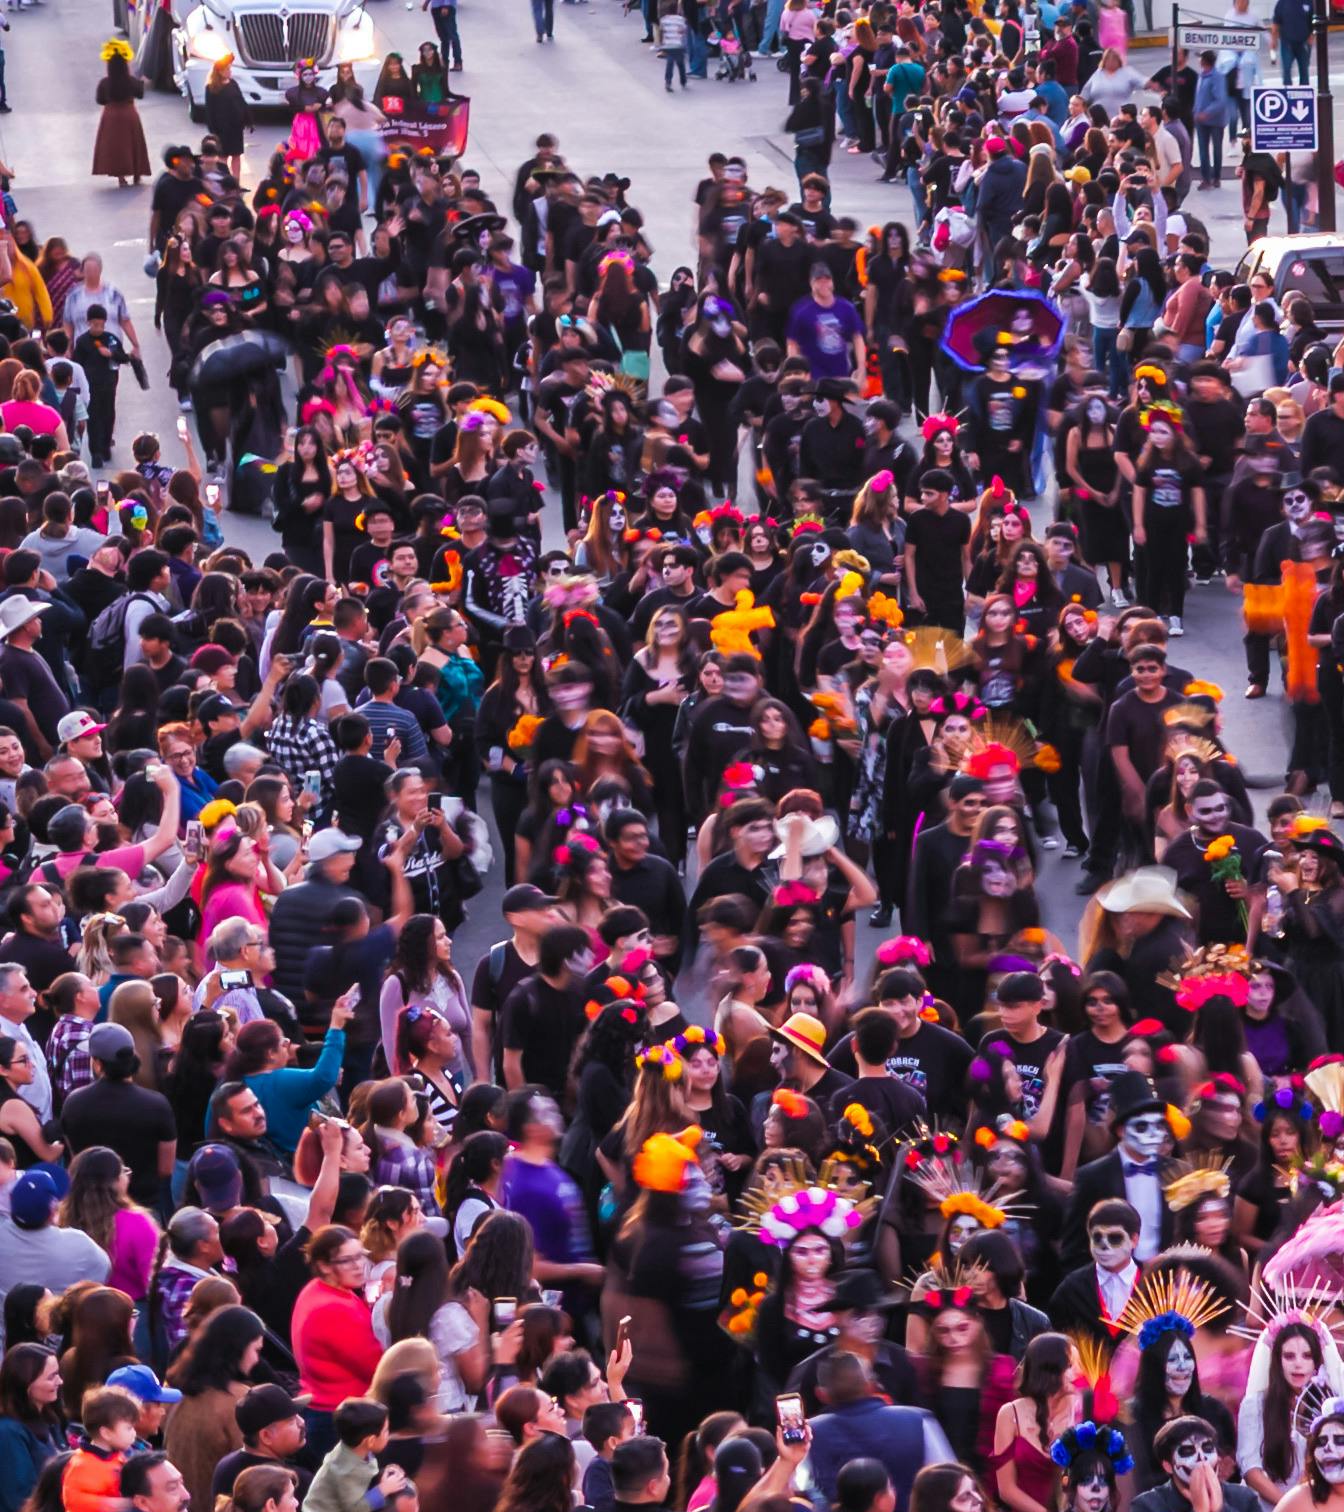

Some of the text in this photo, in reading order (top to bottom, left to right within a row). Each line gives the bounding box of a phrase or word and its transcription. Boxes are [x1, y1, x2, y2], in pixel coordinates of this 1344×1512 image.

[1185, 32, 1256, 47] BENITO JUAREZ
[1264, 95, 1281, 118] P
